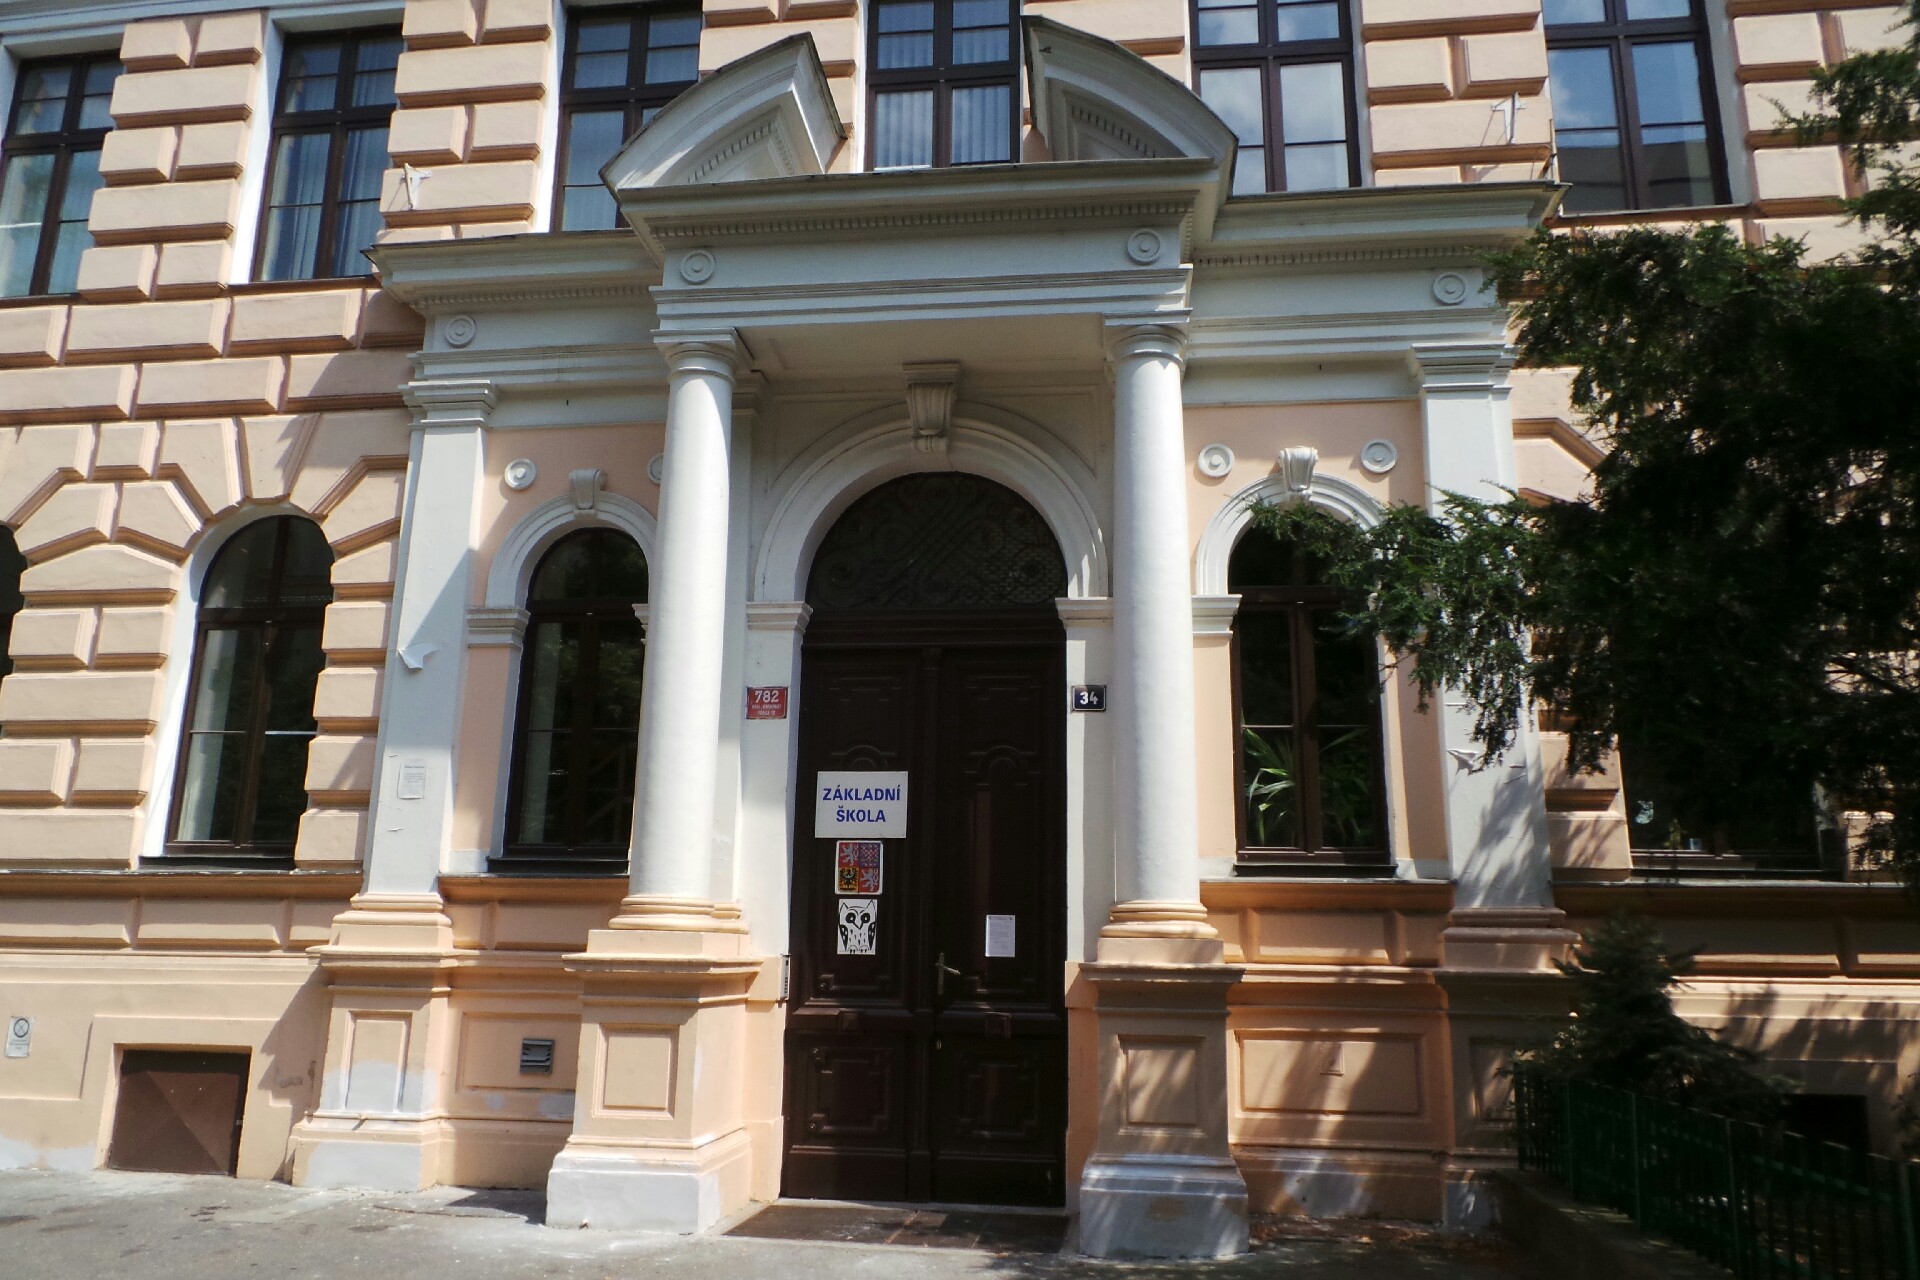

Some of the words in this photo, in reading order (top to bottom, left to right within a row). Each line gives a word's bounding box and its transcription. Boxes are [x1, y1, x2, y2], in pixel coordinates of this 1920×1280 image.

[755, 690, 779, 703] 782
[1080, 691, 1098, 705] 34
[822, 784, 901, 801] ZÁKLADNÍ
[836, 805, 886, 822] ŠKOLA
